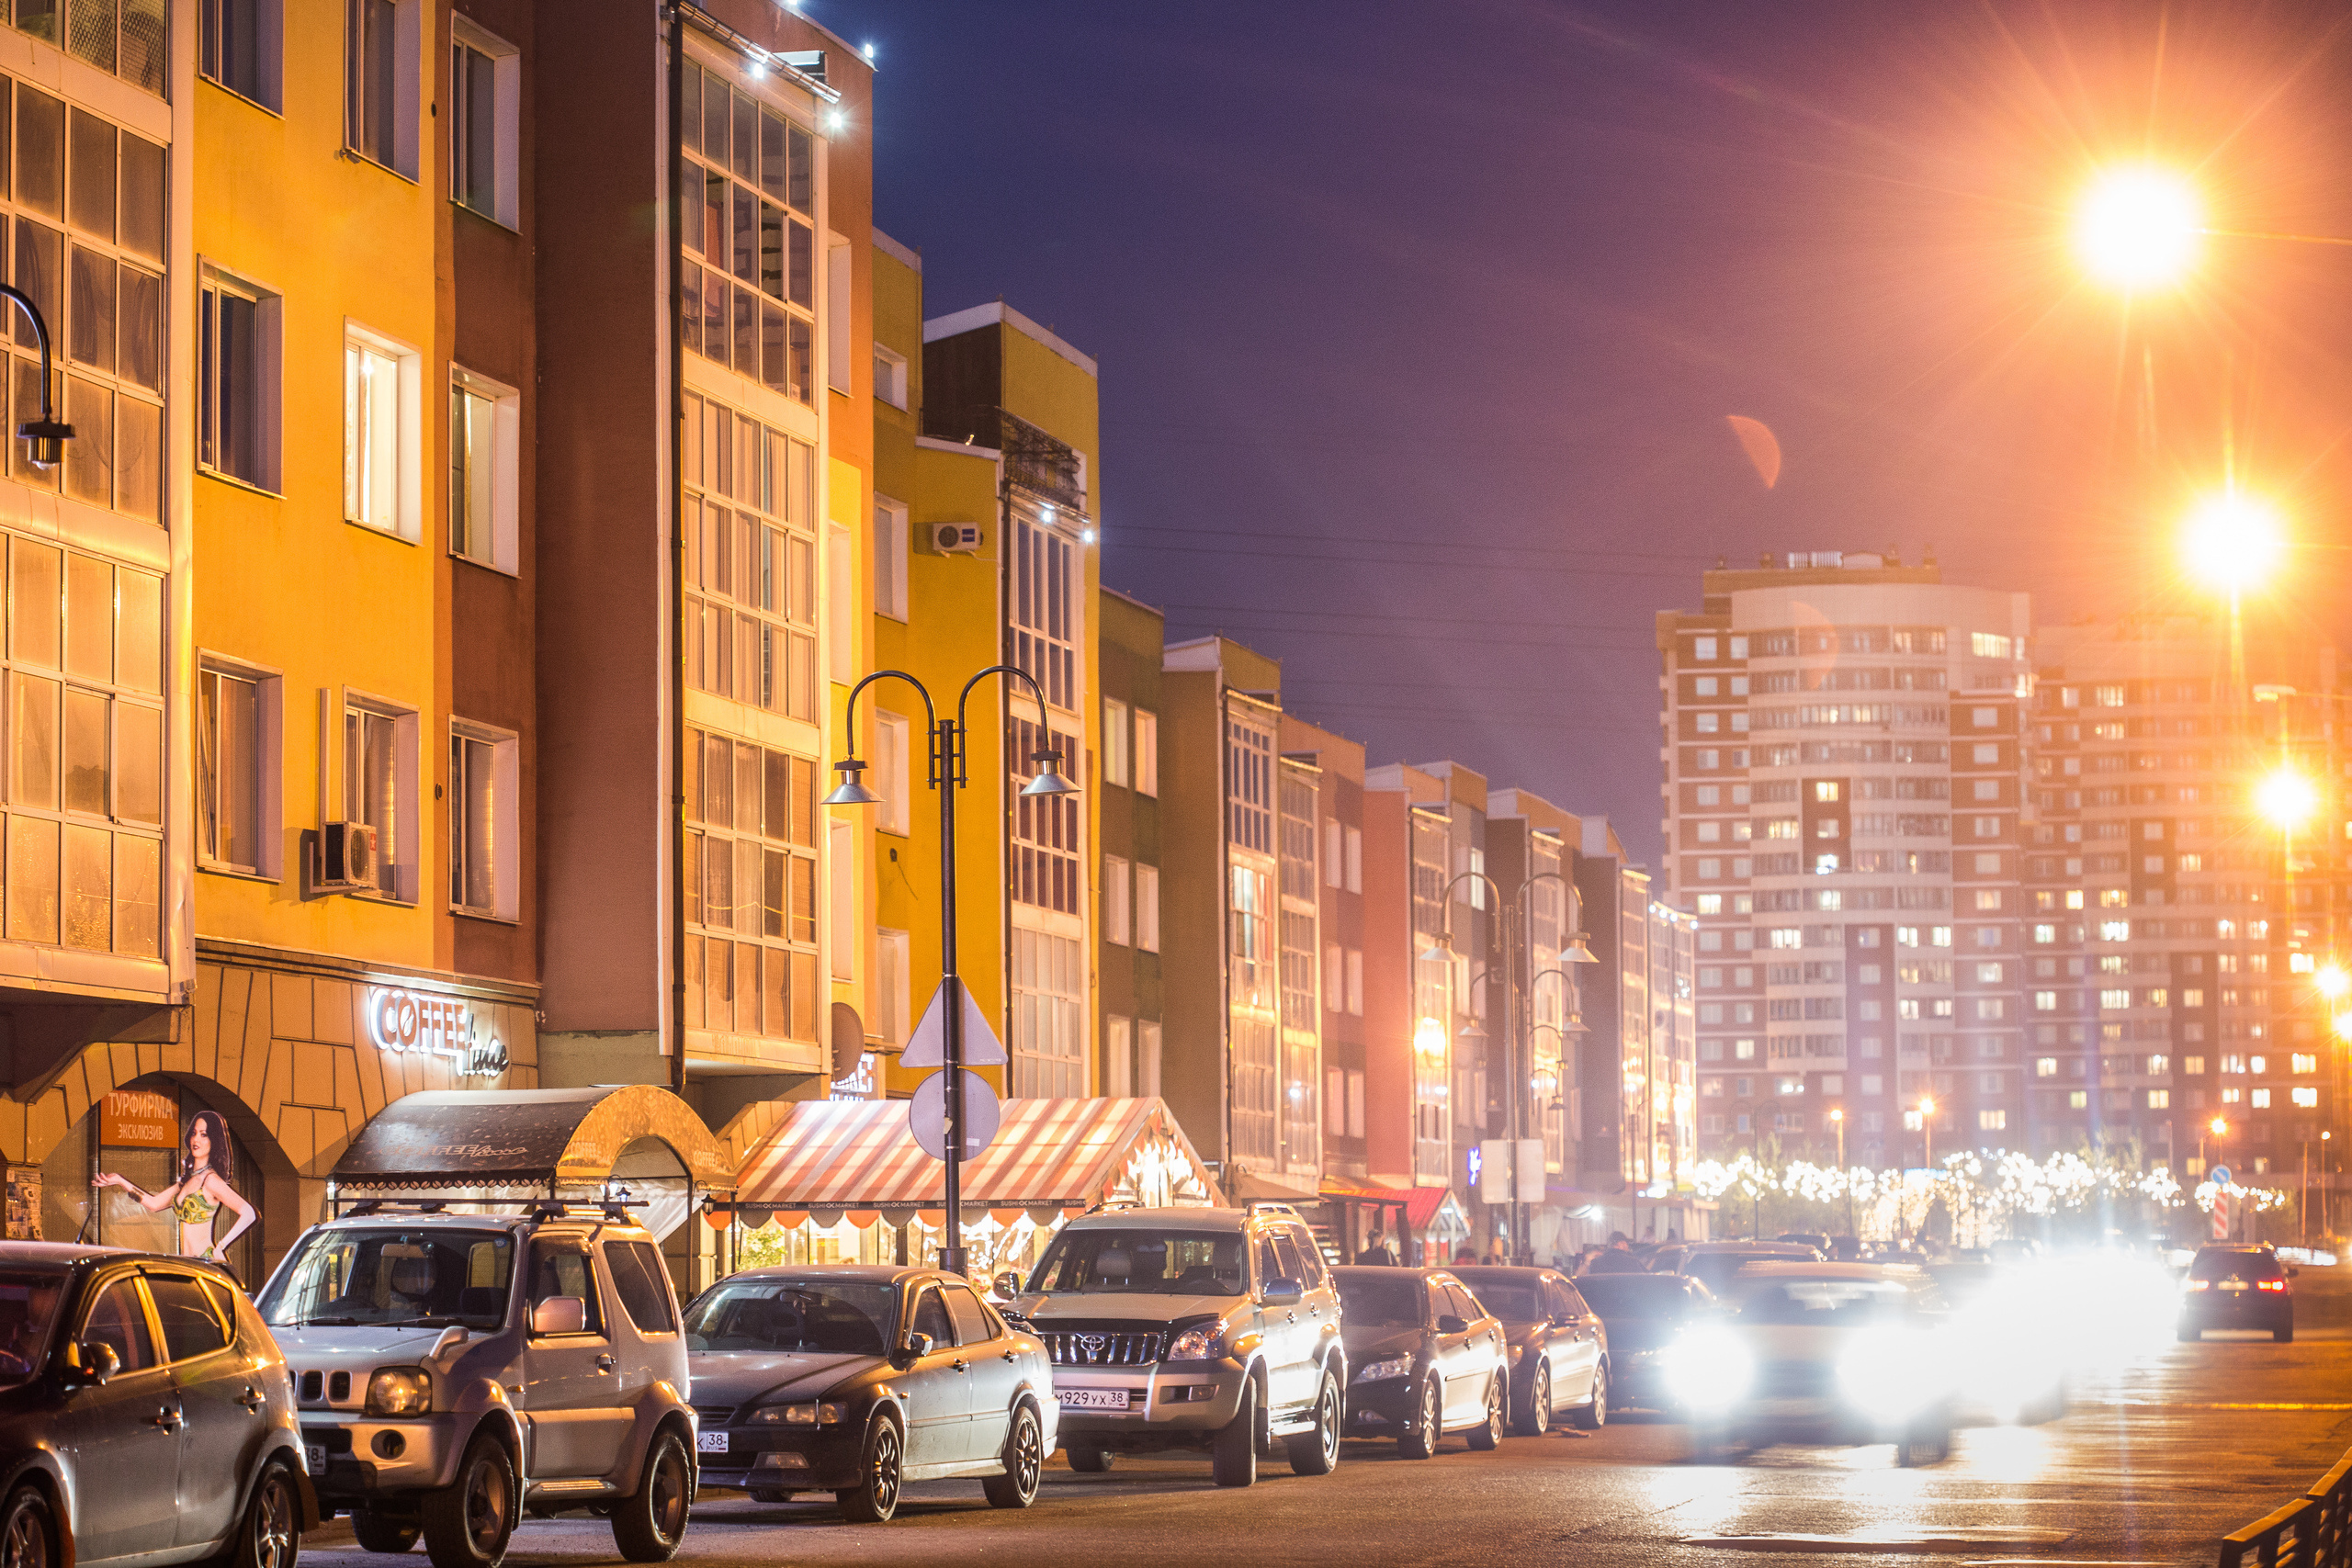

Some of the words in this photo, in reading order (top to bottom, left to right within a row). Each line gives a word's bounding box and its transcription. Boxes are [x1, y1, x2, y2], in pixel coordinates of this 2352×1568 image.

[373, 989, 467, 1056] COFFEE
[108, 1092, 174, 1120] ТУРФИРМА
[118, 1123, 164, 1141] ЭКСКЛЮЗИВ
[1110, 1392, 1124, 1403] 38
[708, 1434, 723, 1446] 38
